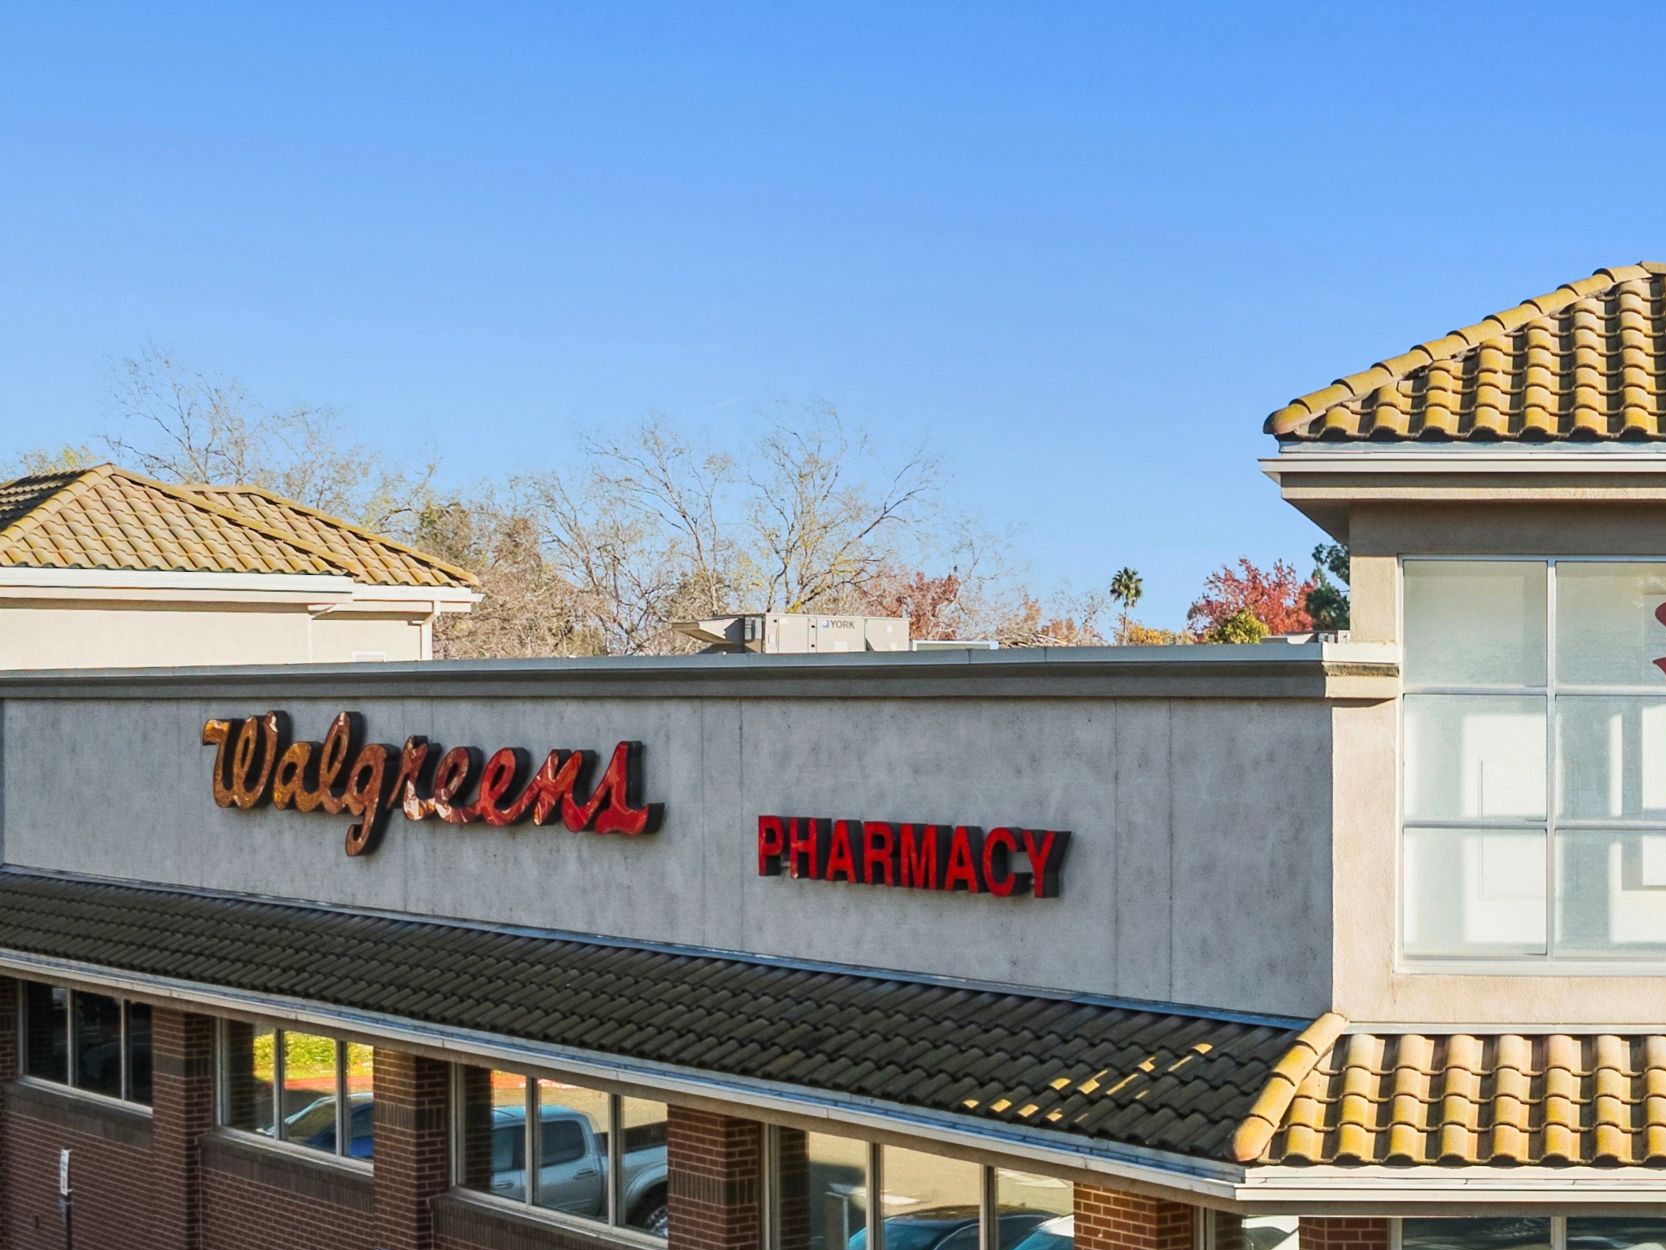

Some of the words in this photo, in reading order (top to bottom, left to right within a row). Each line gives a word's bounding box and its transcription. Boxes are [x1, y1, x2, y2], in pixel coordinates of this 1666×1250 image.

[830, 619, 856, 629] YORK
[201, 709, 662, 857] Walgreens
[758, 814, 1066, 898] PHARMACY
